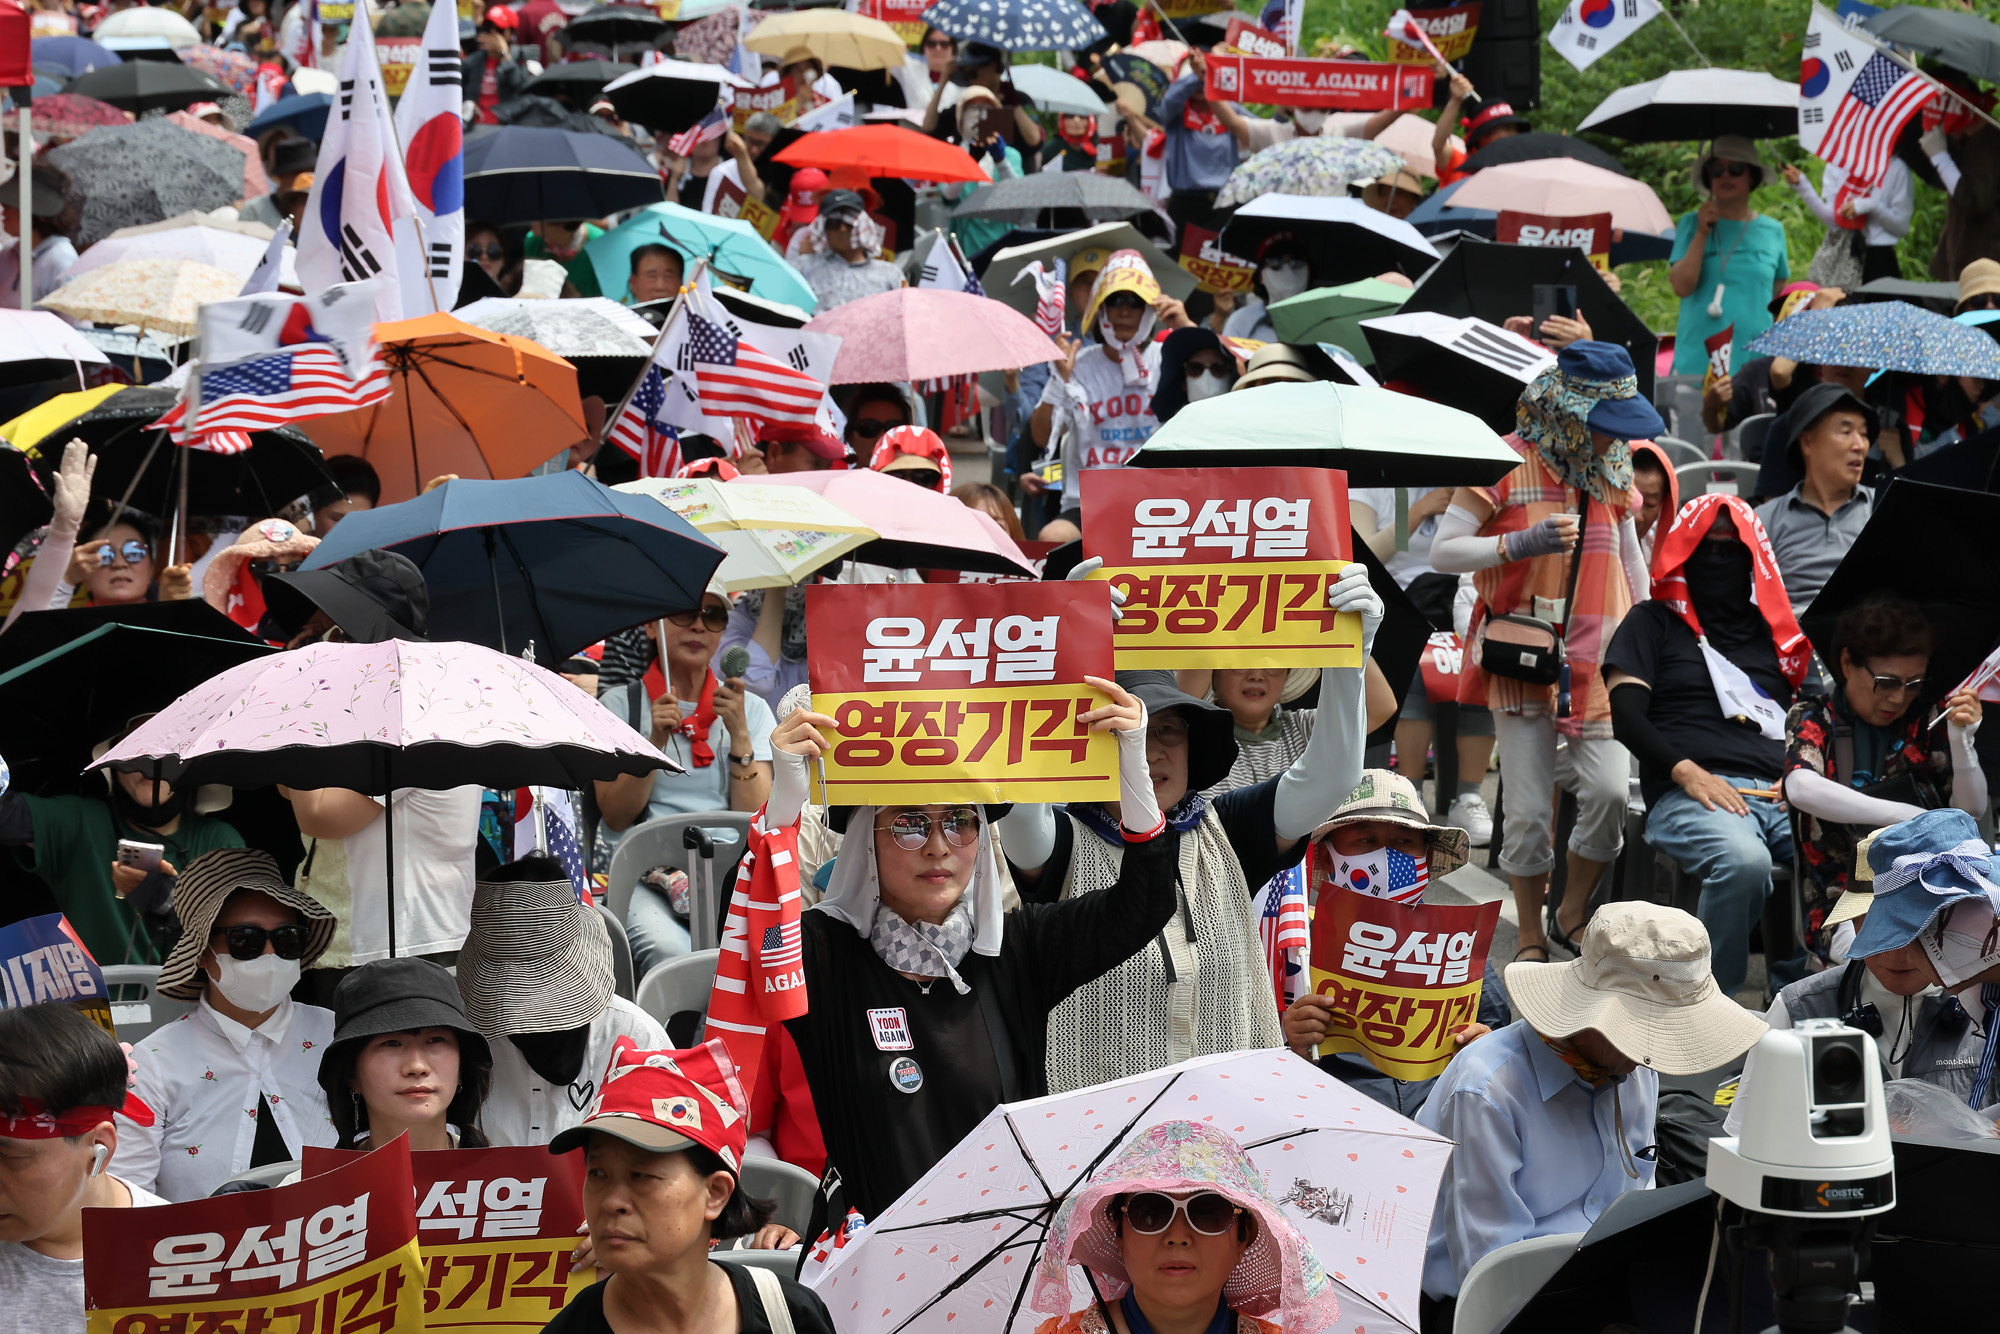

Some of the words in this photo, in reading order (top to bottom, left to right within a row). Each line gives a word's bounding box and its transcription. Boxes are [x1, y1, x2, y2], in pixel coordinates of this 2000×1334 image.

[1314, 74, 1379, 91] AGAIN
[1187, 259, 1253, 289] 영장기
[1101, 425, 1154, 441] GREAT
[1131, 497, 1312, 559] 윤석열
[1108, 573, 1340, 635] 영장기각
[862, 615, 1061, 684] 윤석열
[833, 698, 1094, 766] 영장기각
[1341, 920, 1478, 986] 윤석열
[876, 1016, 901, 1030] YOON
[879, 1030, 907, 1043] AGAIN
[1316, 978, 1477, 1051] 영장기각
[414, 1177, 548, 1241] 석열
[1825, 1187, 1865, 1198] EDISTEC
[149, 1191, 371, 1298] 윤석열
